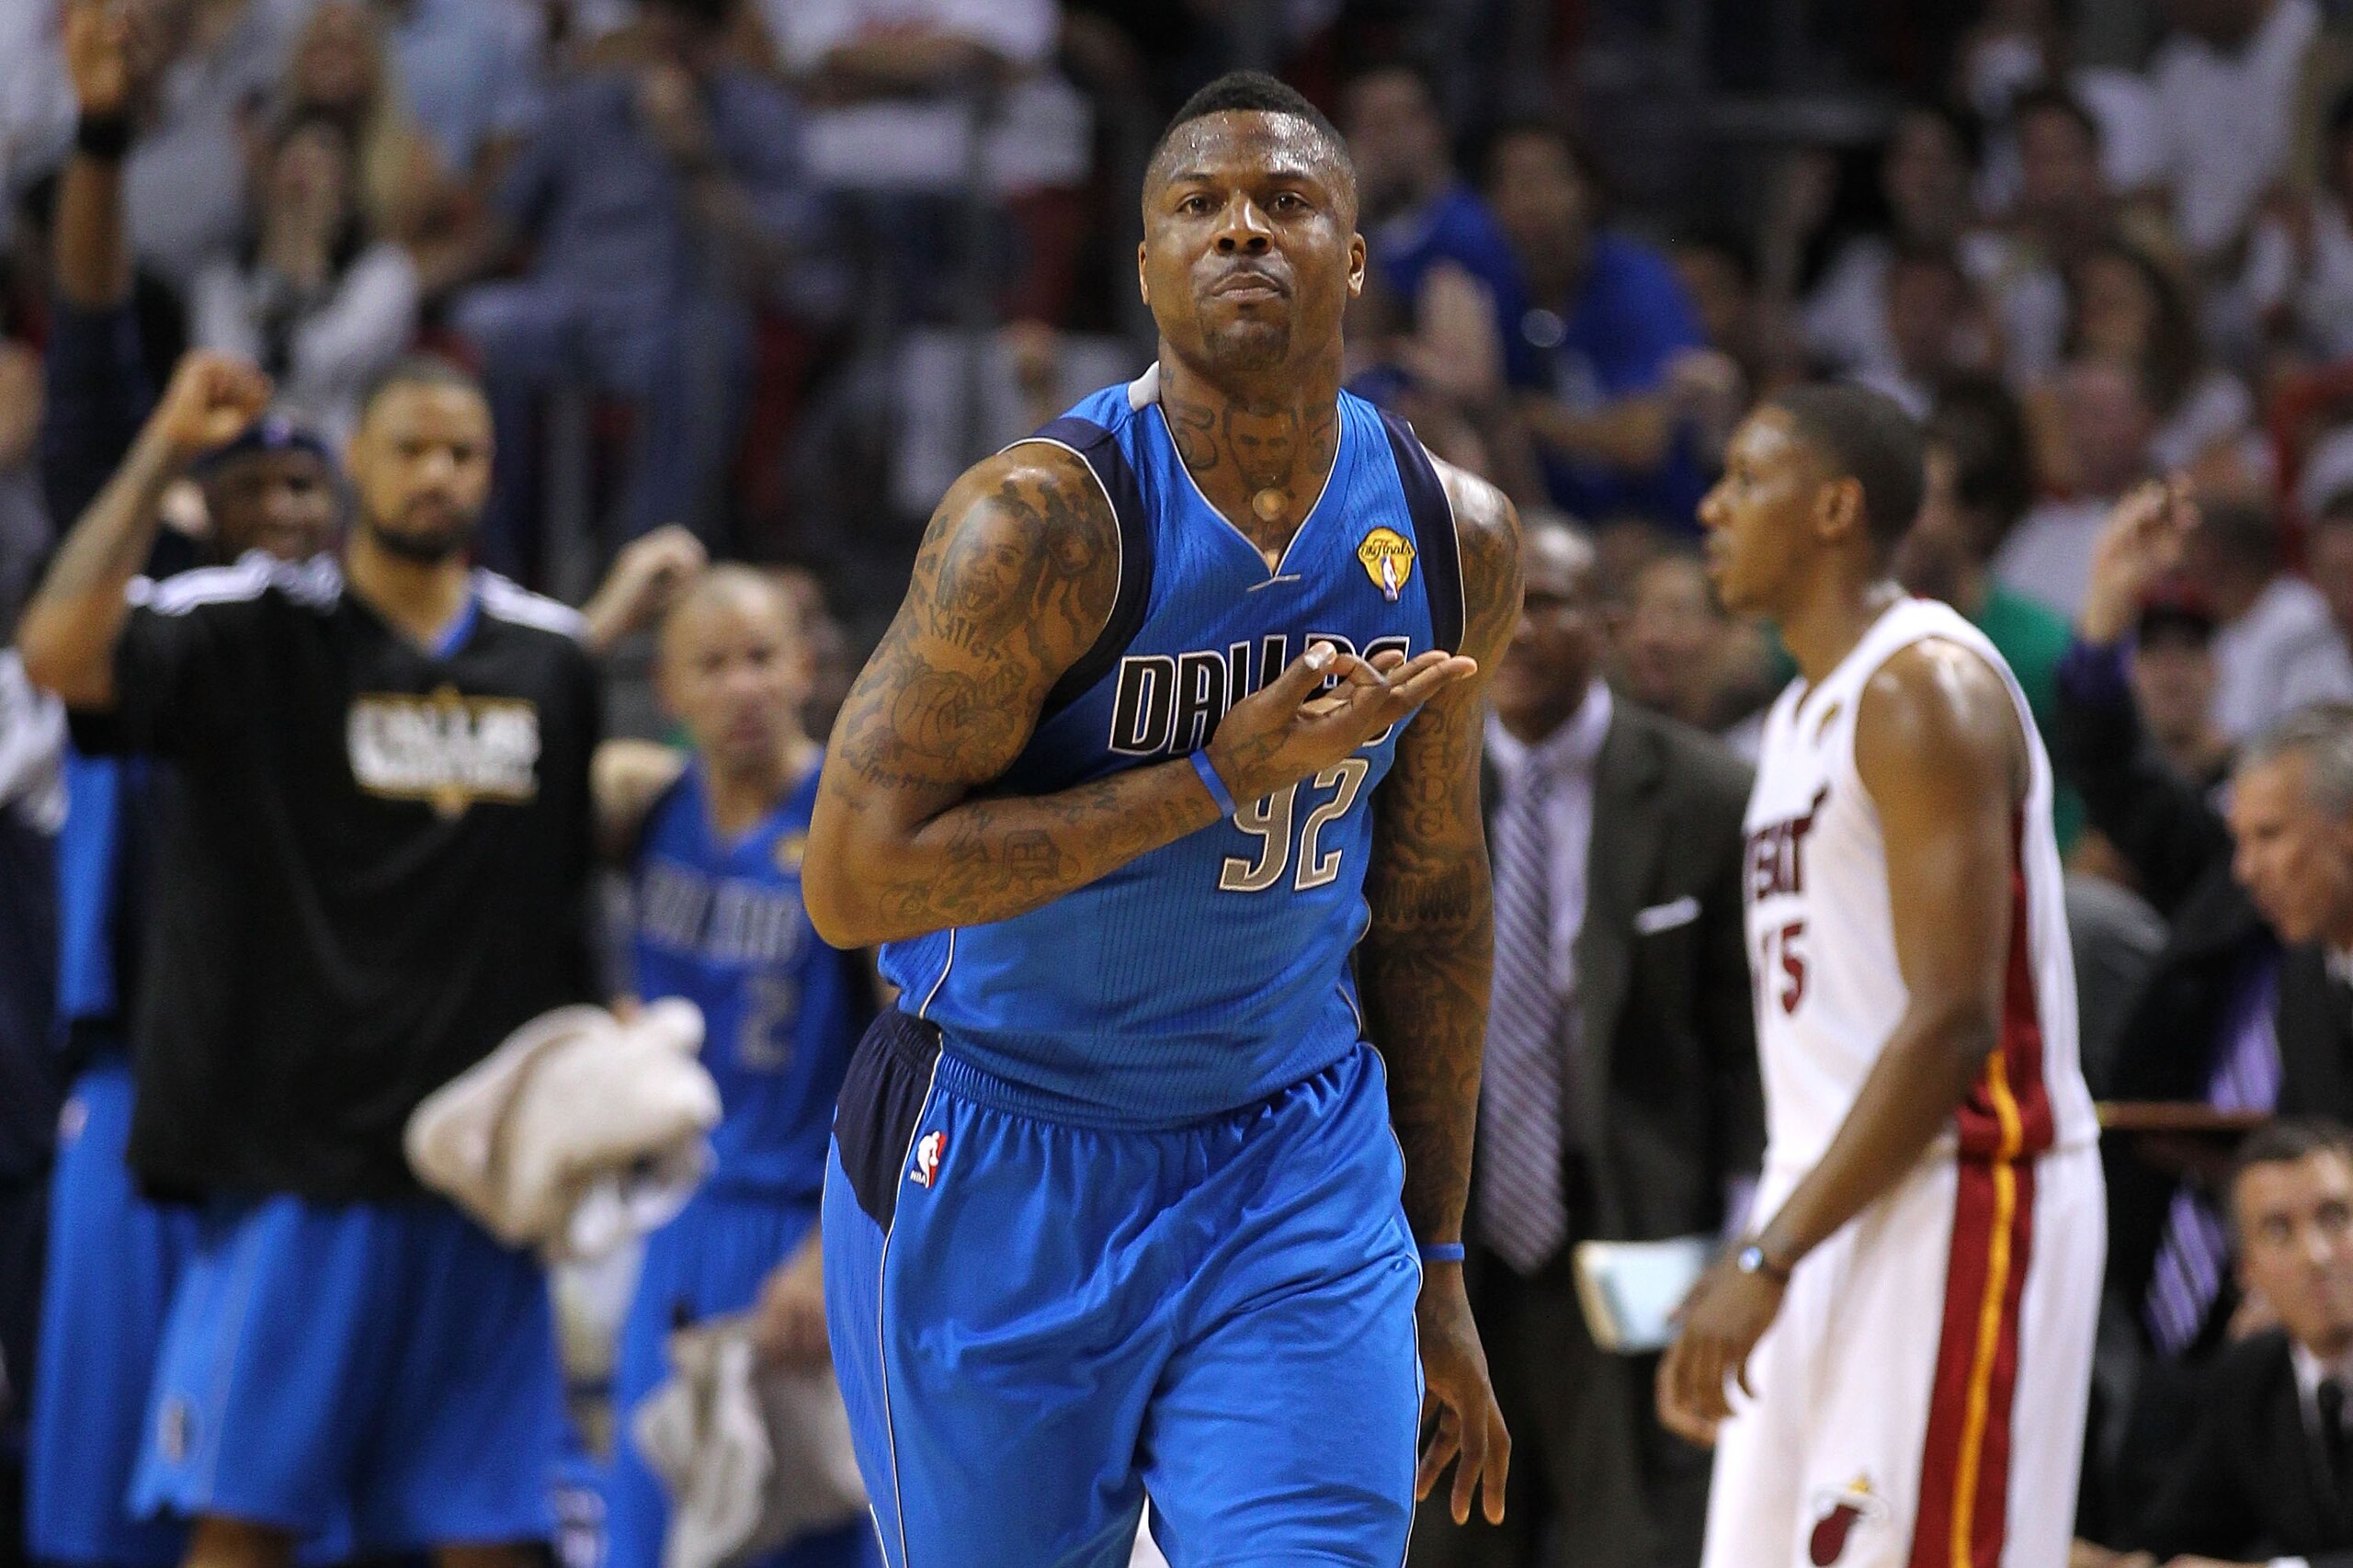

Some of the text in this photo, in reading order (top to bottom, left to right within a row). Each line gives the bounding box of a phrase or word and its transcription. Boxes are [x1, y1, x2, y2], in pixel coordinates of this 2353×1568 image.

[1373, 538, 1412, 559] Finals
[1219, 757, 1370, 892] 92
[909, 1169, 926, 1185] NBA
